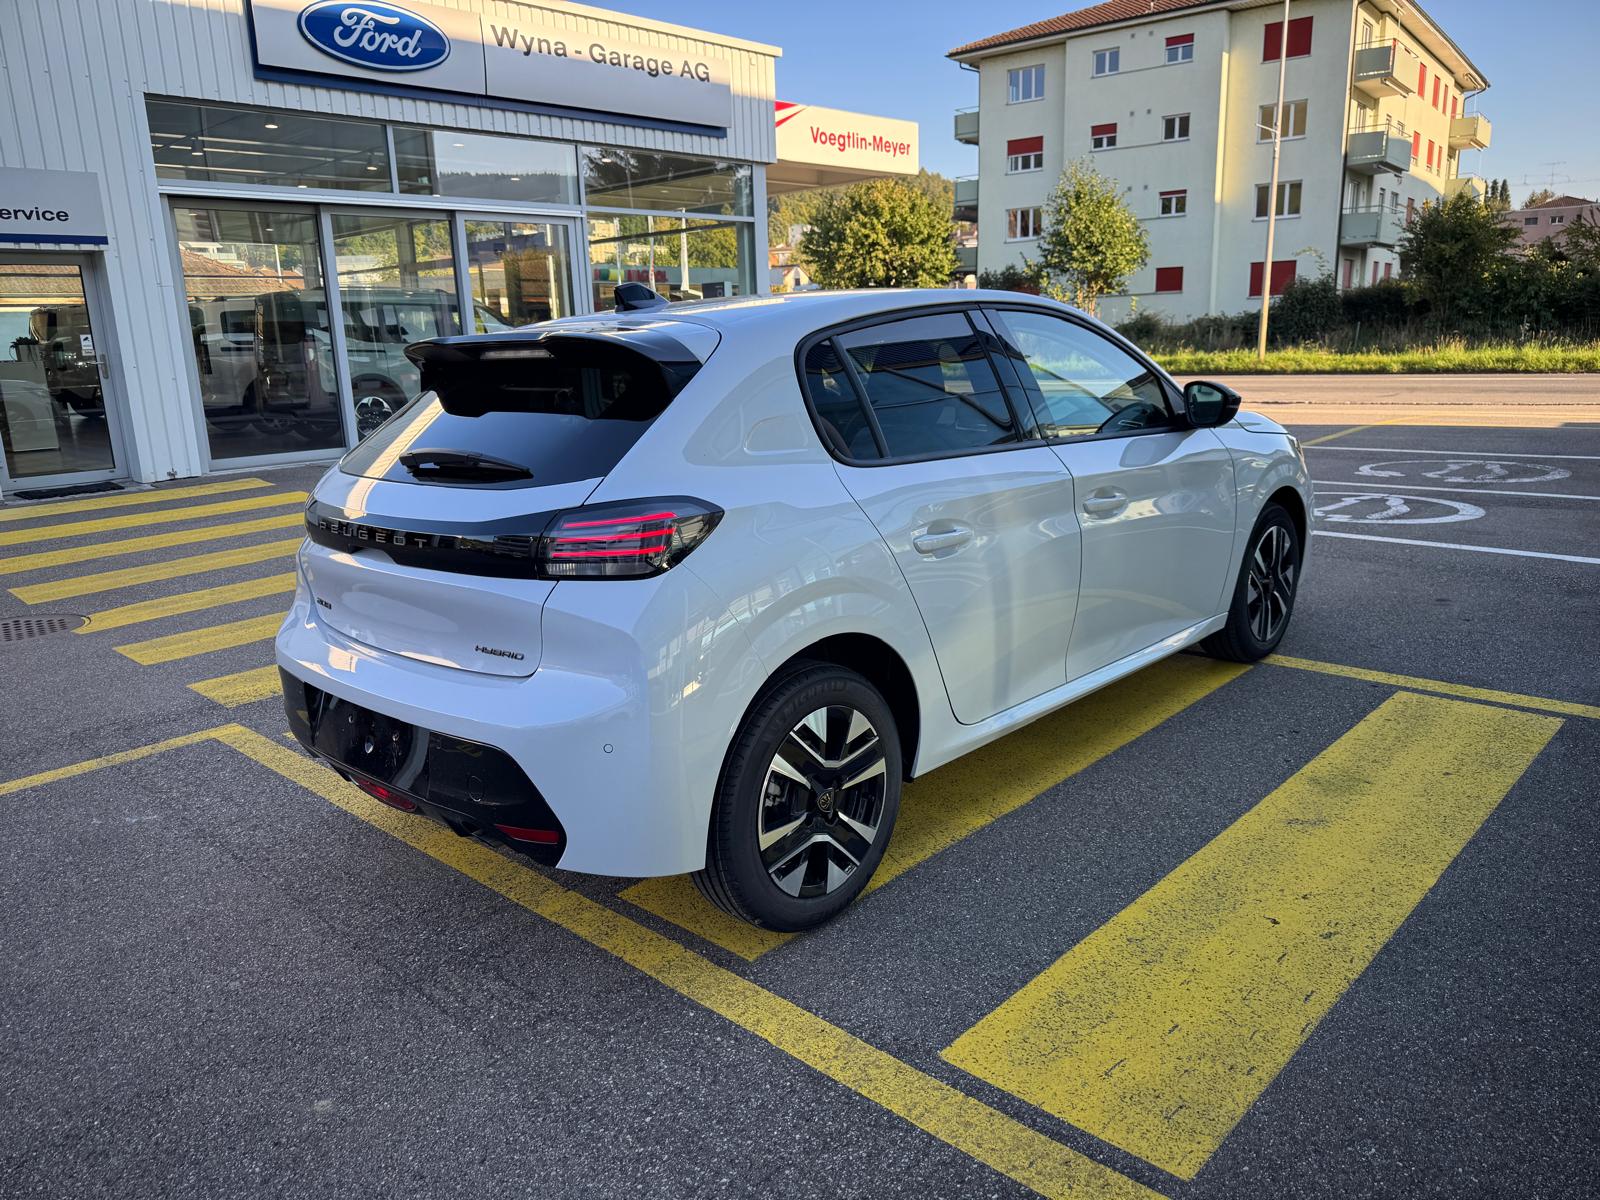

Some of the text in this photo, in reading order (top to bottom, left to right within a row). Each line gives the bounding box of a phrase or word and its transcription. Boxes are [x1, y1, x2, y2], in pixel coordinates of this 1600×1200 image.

[333, 7, 423, 58] Ford
[490, 24, 568, 56] Wyna
[589, 43, 673, 77] Garage
[680, 60, 710, 82] AG
[810, 126, 911, 157] Voegtlin-Meyer
[0, 207, 69, 222] ervice
[319, 521, 427, 549] PEUGEOT
[475, 644, 525, 661] HYBRID
